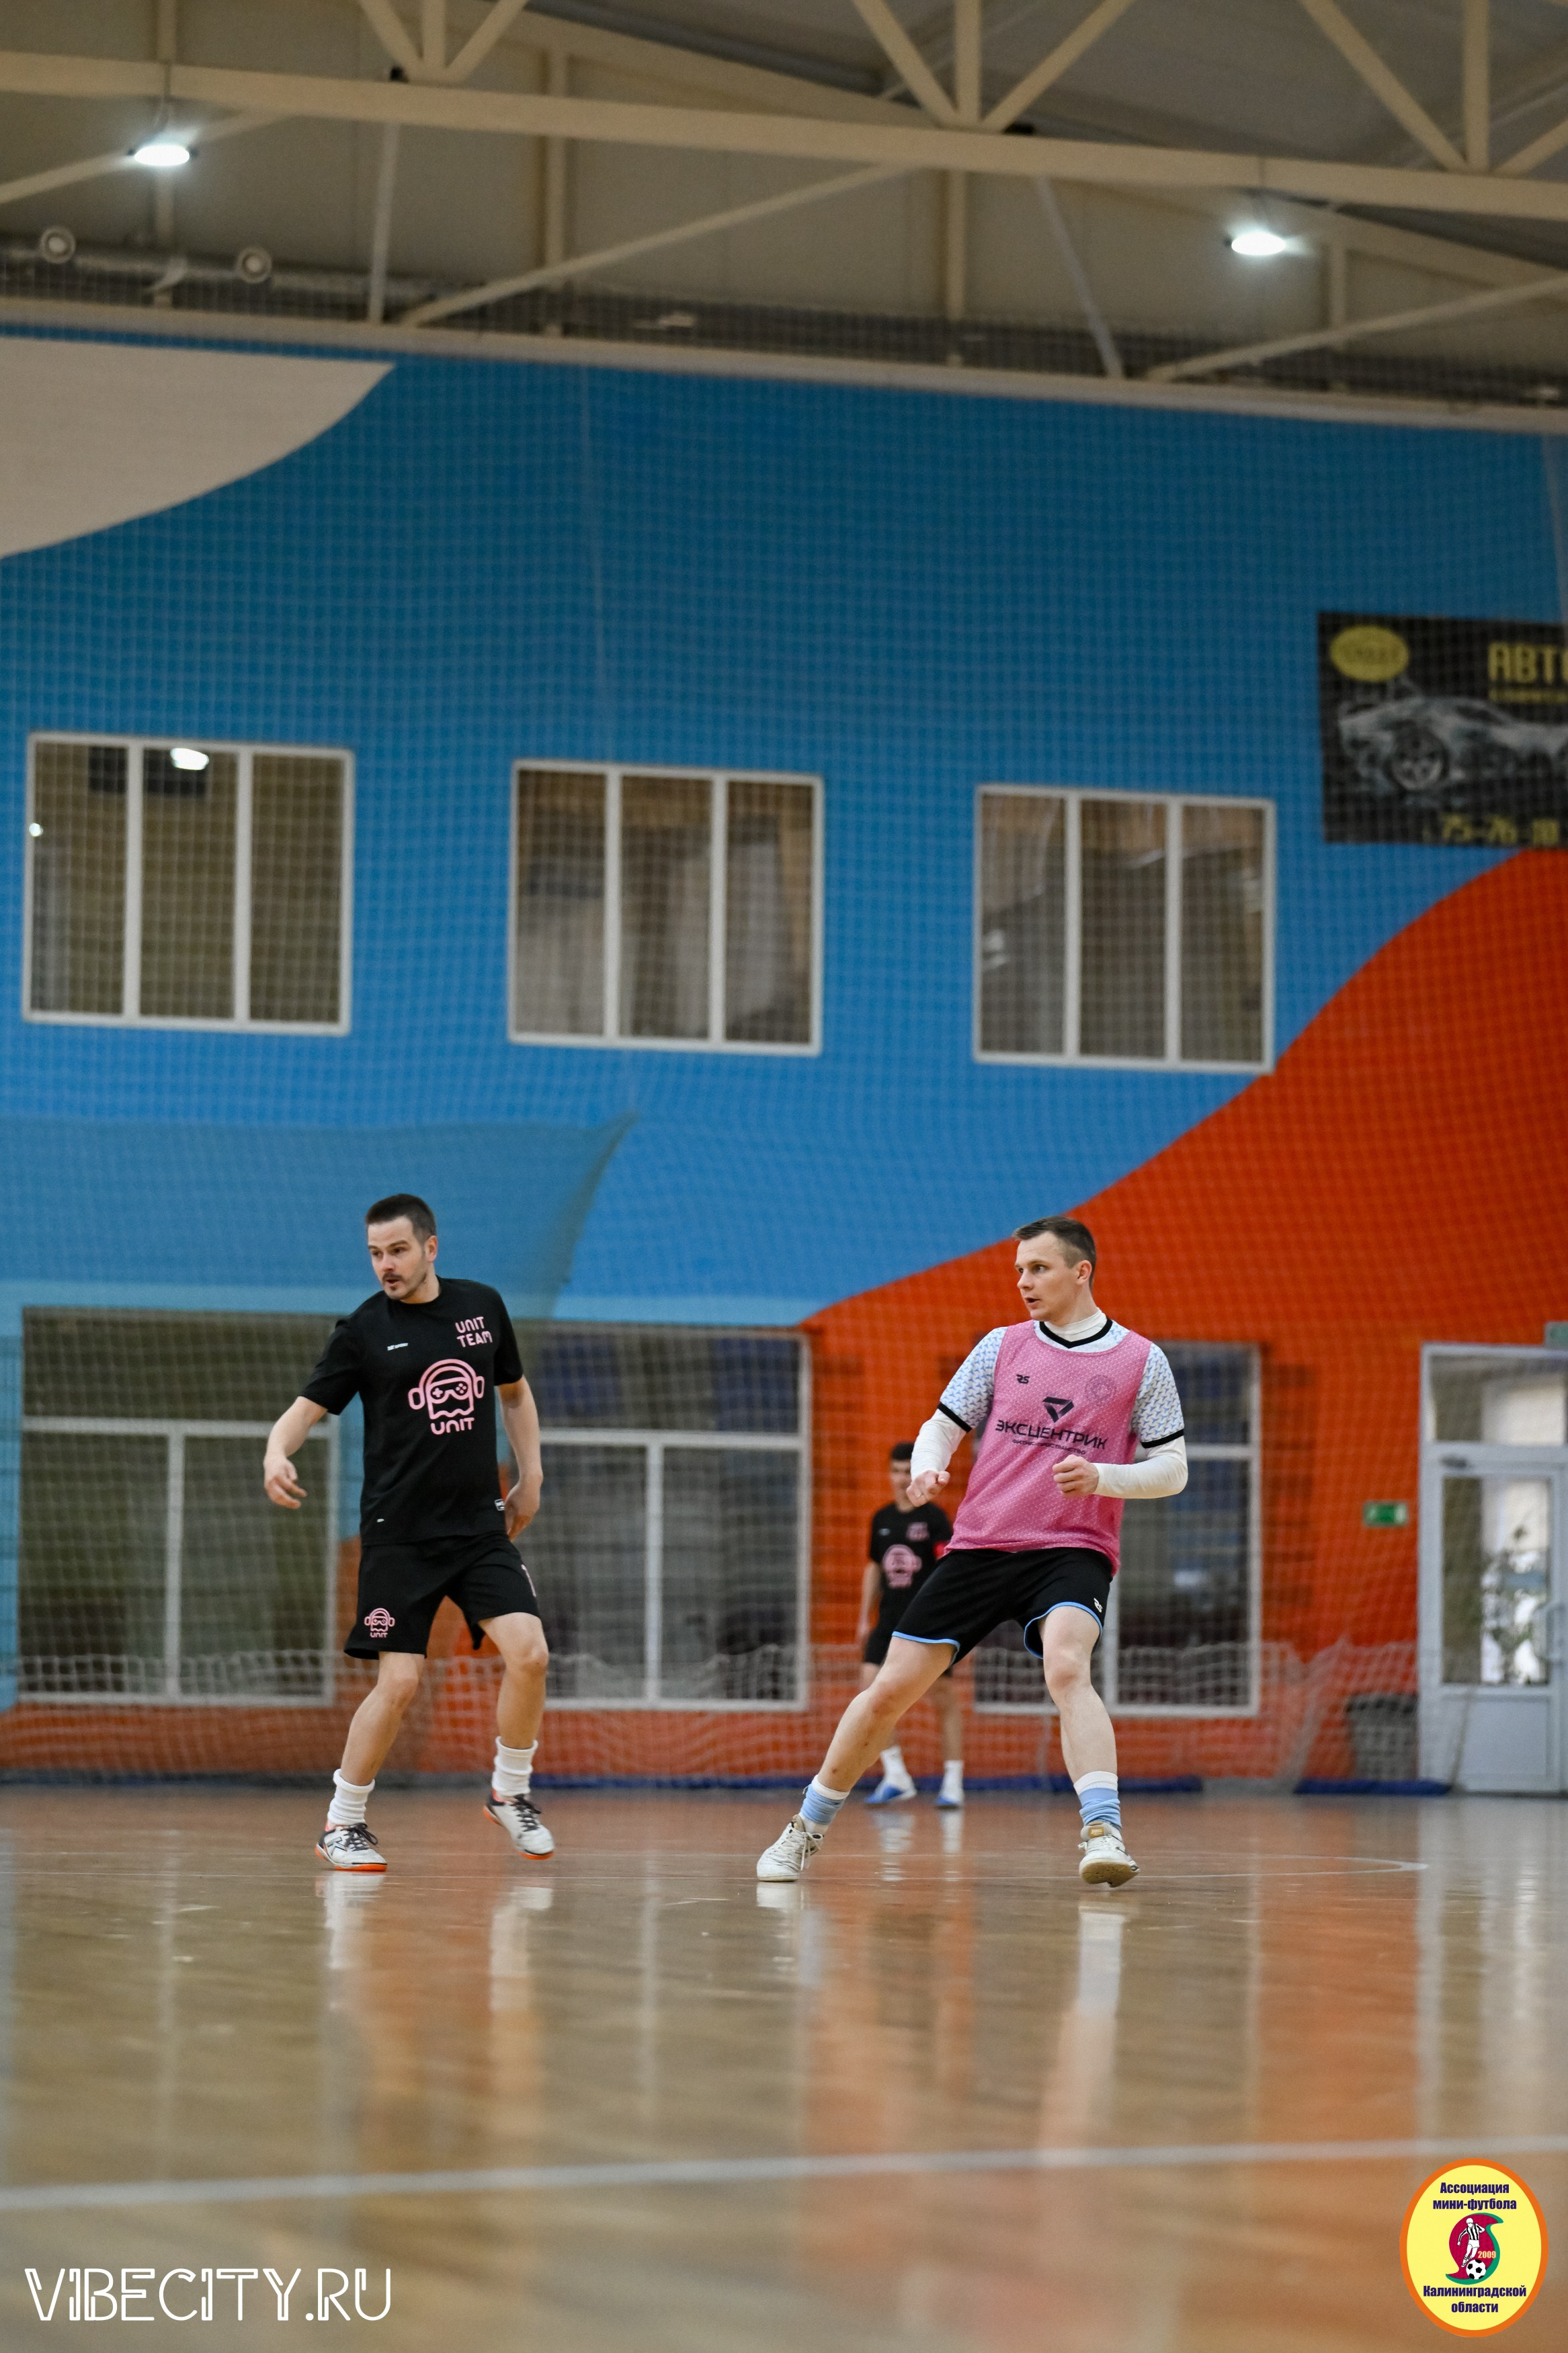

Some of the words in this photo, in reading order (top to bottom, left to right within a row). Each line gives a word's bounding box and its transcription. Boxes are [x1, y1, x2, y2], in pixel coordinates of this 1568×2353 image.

[455, 1316, 485, 1334] UNIT
[456, 1330, 493, 1348] TEAM
[430, 1417, 475, 1435] UNIT
[995, 1419, 1108, 1449] ЭКСЦЕНТРИК
